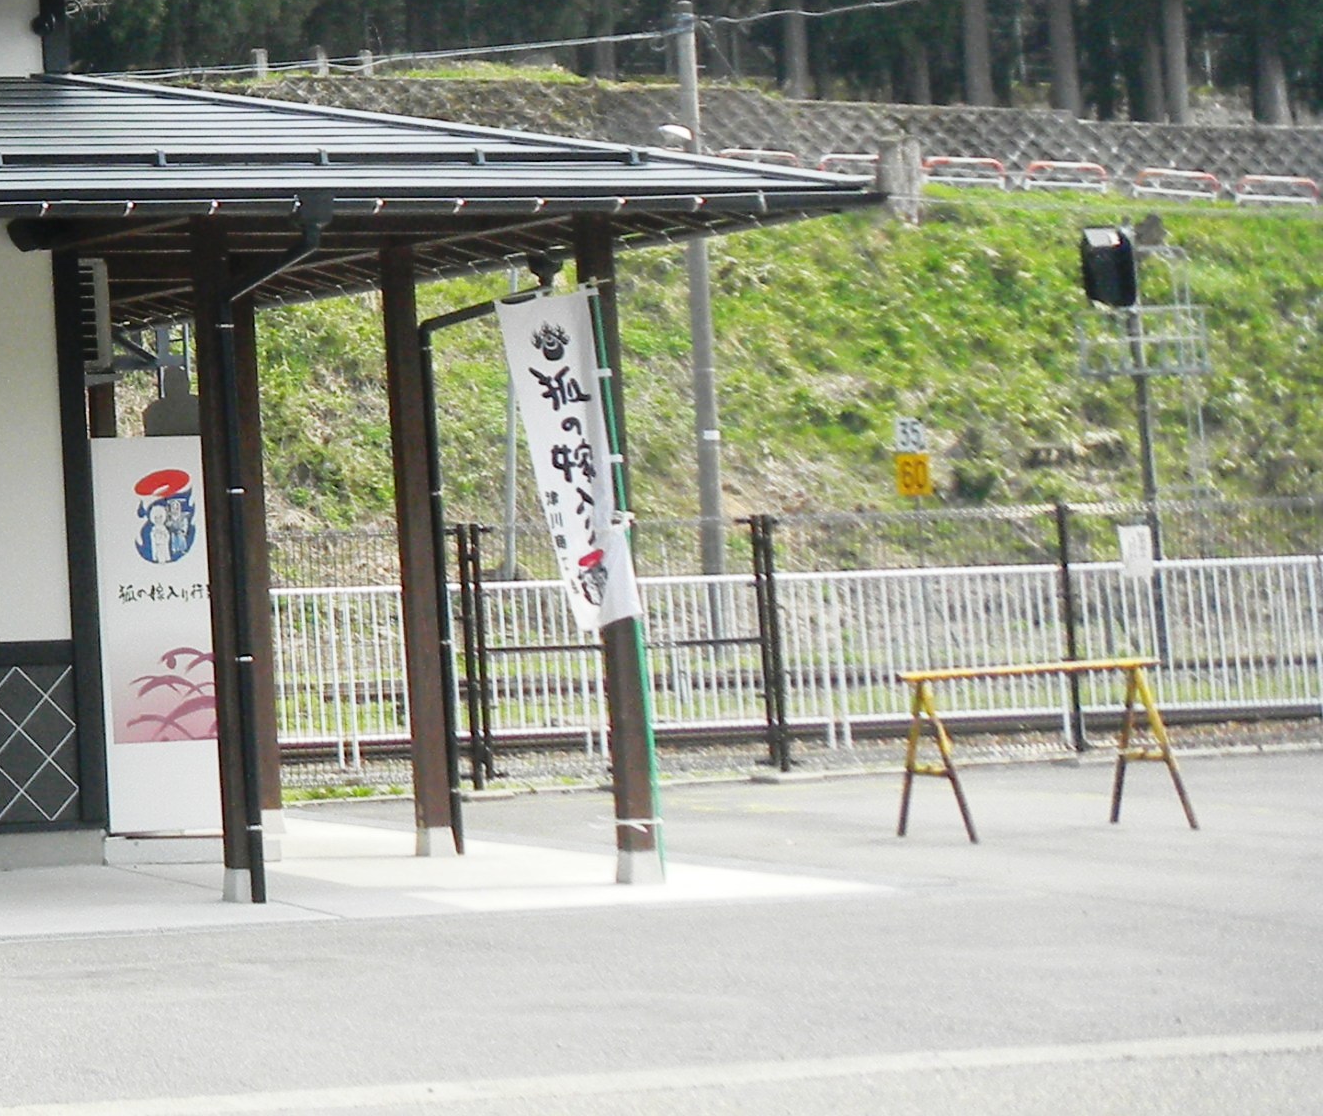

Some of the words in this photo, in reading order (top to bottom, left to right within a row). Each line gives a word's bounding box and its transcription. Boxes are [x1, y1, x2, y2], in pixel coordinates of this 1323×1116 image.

[901, 461, 927, 489] 60
[118, 583, 210, 604] 狐の嫁入り行
